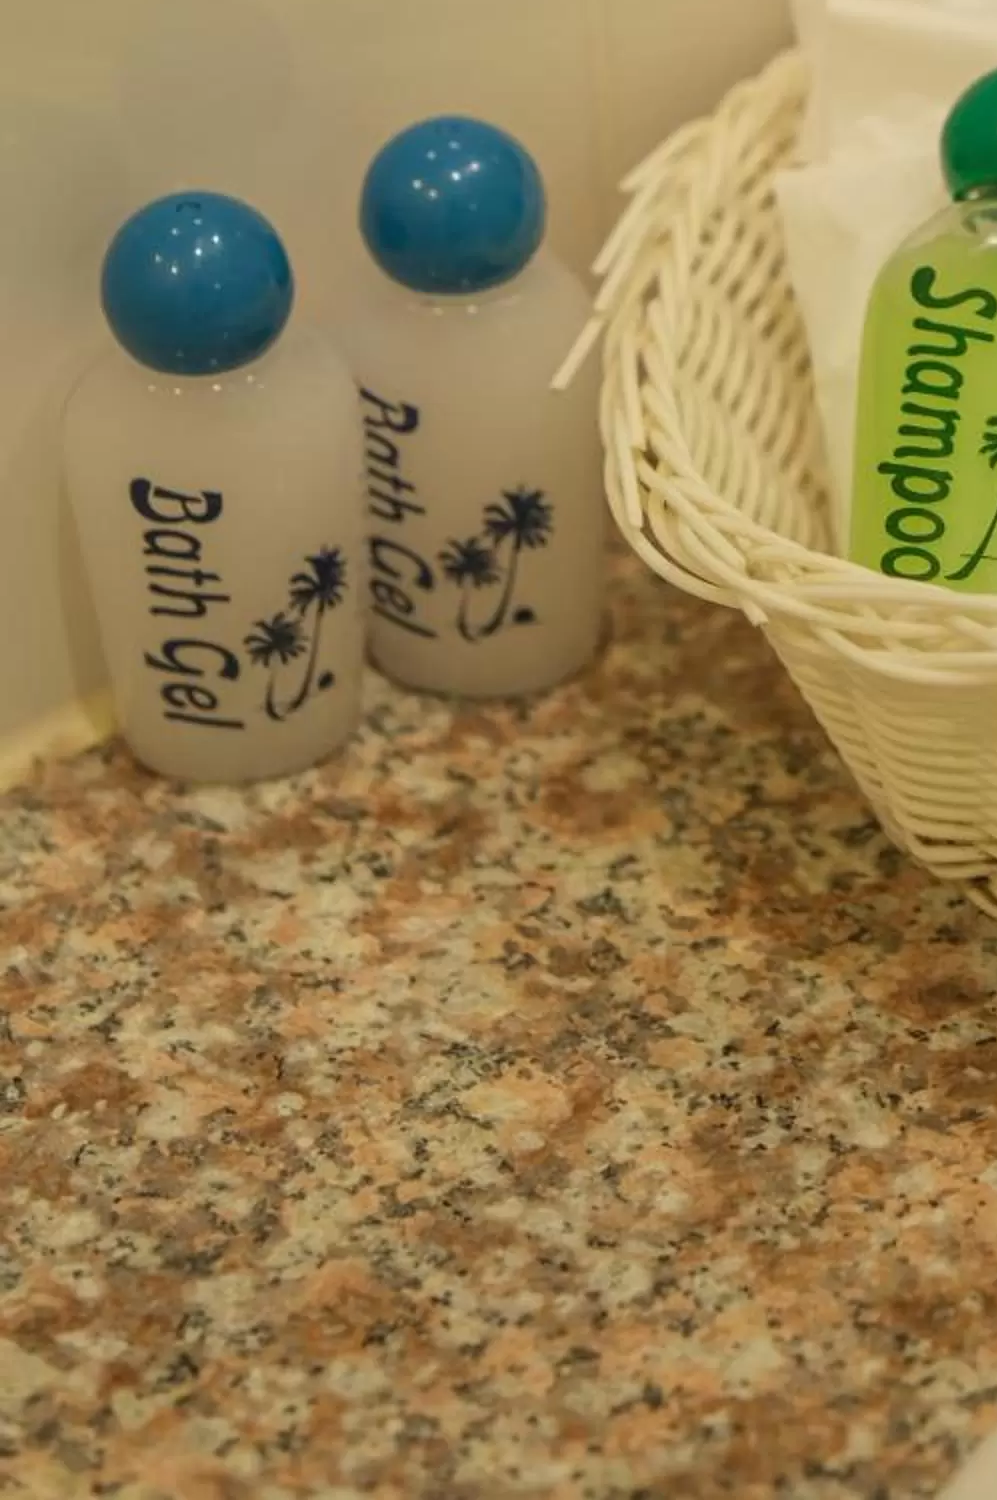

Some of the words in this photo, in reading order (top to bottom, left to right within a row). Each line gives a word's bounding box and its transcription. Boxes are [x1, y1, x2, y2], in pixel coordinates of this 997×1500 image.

[129, 477, 230, 618] Bath
[368, 536, 438, 638] Gel
[144, 639, 244, 730] Gel
